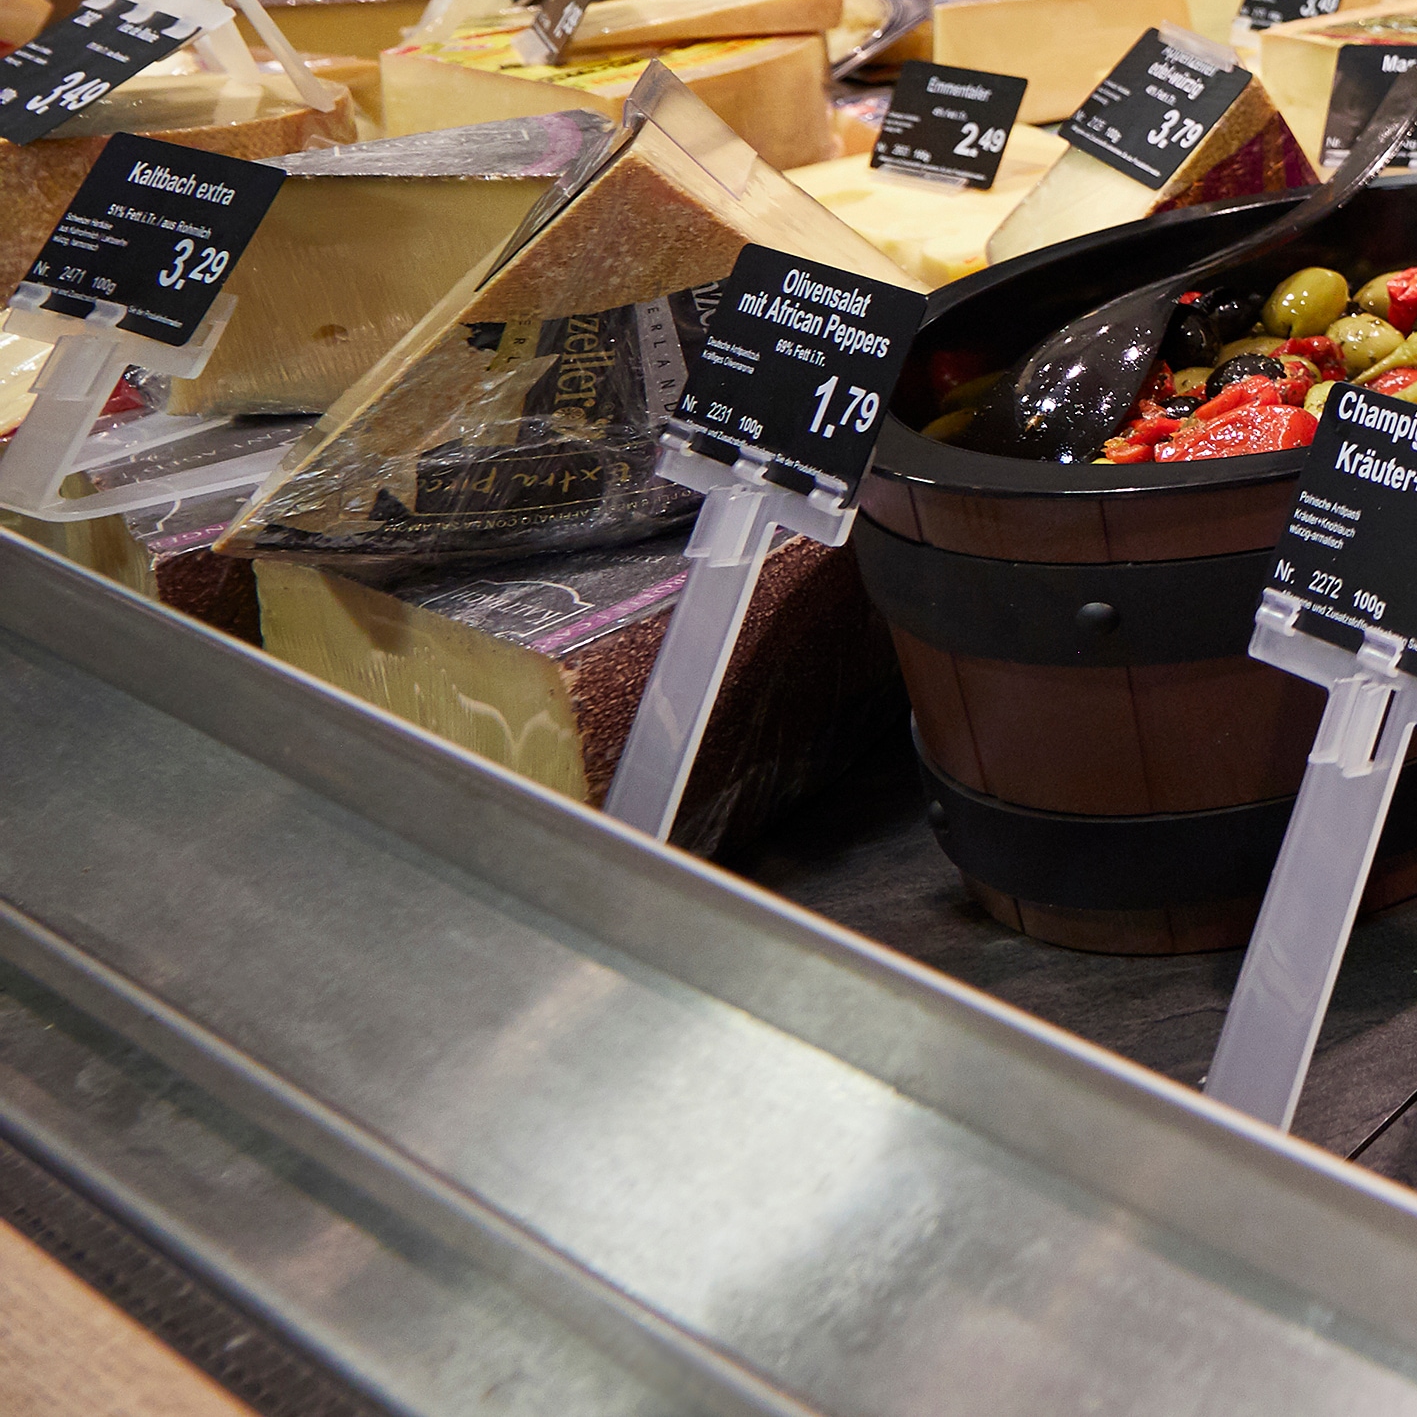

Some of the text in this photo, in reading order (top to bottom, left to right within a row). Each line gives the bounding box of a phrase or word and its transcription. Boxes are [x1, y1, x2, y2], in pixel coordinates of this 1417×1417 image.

[26, 71, 111, 115] 3.49
[926, 75, 993, 103] Emmentaler
[953, 121, 1007, 159] 2.49
[1147, 109, 1204, 150] 3.79
[128, 161, 236, 206] Kaltbach extra
[125, 207, 142, 223] Fett
[161, 218, 176, 230] aus
[33, 260, 50, 277] Nr.
[92, 276, 117, 296] 100g
[159, 238, 230, 290] 3.29
[782, 268, 873, 318] Olivensalat
[738, 292, 768, 317] mit
[765, 296, 824, 337] African
[822, 314, 891, 359] Peppers
[775, 338, 794, 356] 69%
[793, 344, 812, 362] Fett
[682, 394, 763, 439] Nr. 2231 100g
[809, 375, 880, 439] 1.79
[1299, 490, 1361, 522] Polnische Antipasti
[1273, 559, 1386, 620] Nr. 2272 100g
[1311, 602, 1325, 616] und
